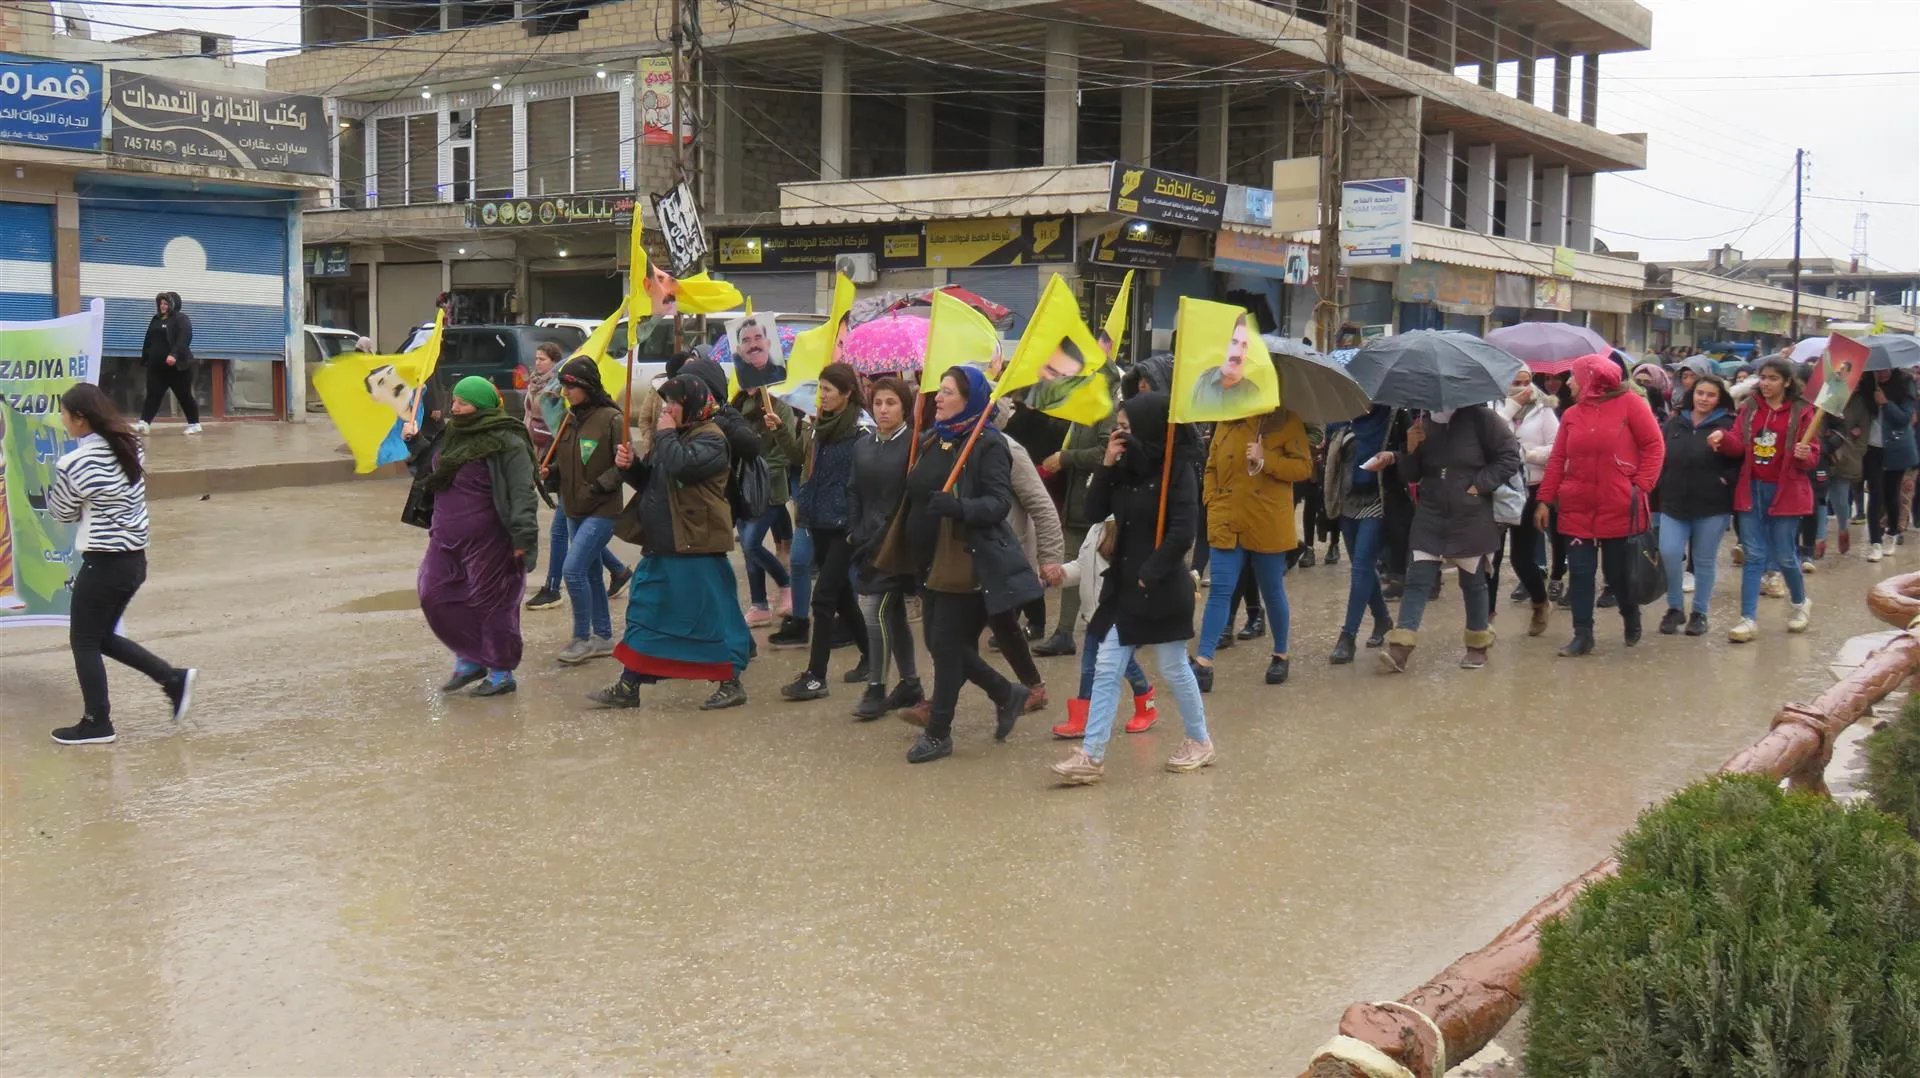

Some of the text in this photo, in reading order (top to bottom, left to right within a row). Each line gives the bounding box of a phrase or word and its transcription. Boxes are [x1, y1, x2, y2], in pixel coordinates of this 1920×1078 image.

[122, 85, 307, 131] مكتب التجارة و التعهدات
[58, 113, 89, 129] لتجارة
[123, 136, 162, 152] 745 745
[198, 144, 227, 160] يوسف
[239, 138, 307, 154] سيارات عقارات
[260, 153, 289, 168] أراضي
[1154, 177, 1217, 207] شركة الحافظ
[564, 199, 593, 223] الحارة
[789, 237, 817, 251] للحوالات
[819, 236, 842, 248] الحافظ
[845, 234, 869, 248] شركة
